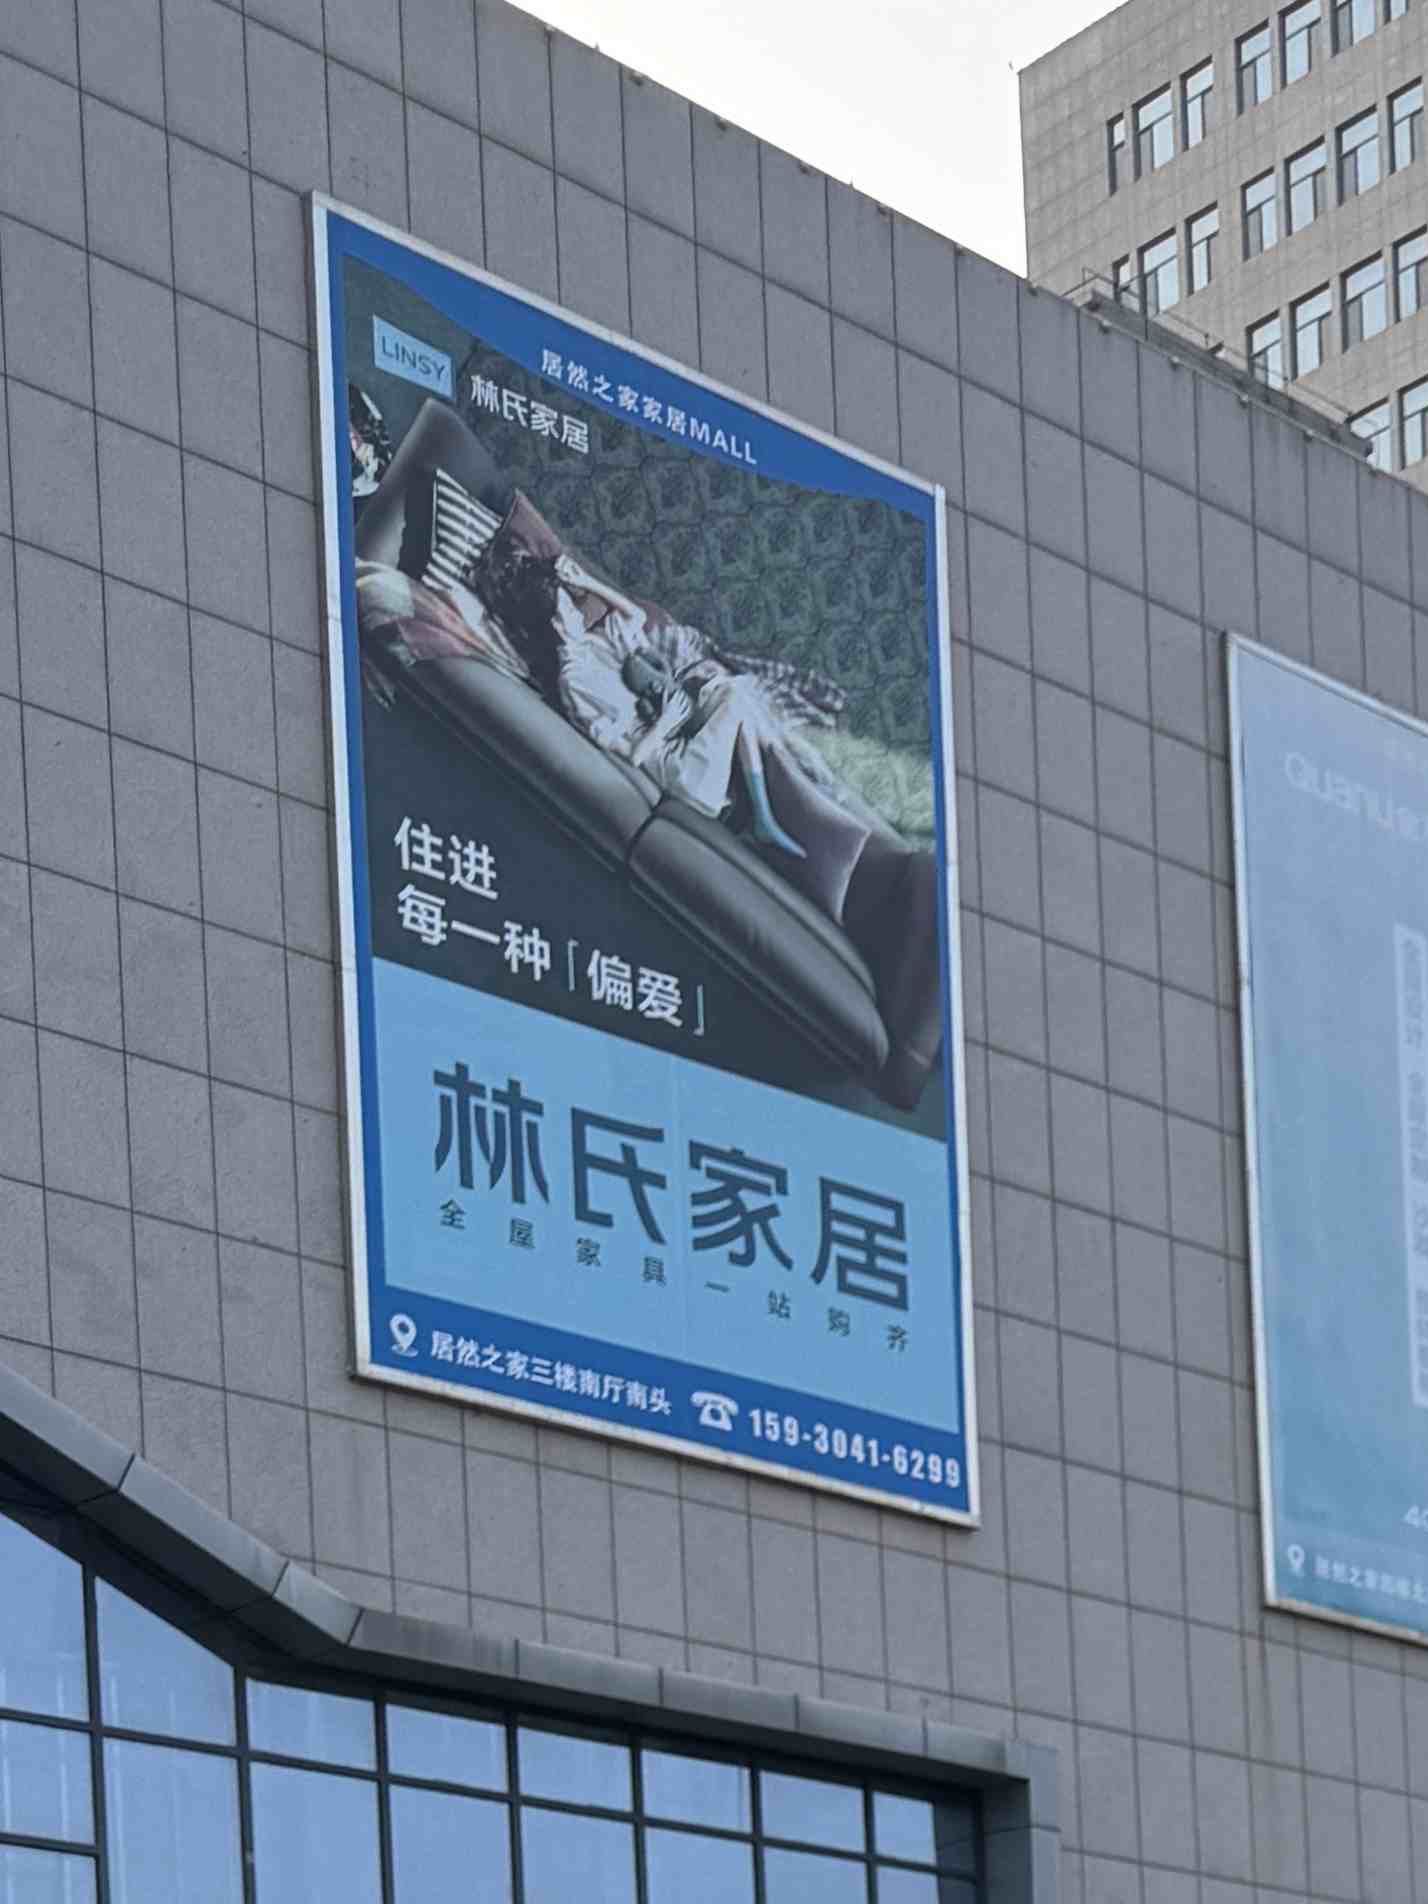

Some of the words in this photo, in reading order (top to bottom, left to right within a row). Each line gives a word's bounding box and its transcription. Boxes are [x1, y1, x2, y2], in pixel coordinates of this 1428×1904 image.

[379, 336, 447, 378] LINSY
[471, 374, 589, 455] 林氏家居
[541, 348, 757, 464] 居然之家家居MALL
[394, 816, 498, 900] 住进
[433, 1062, 909, 1312] 林氏家居
[749, 1408, 962, 1490] 159-3041-6299
